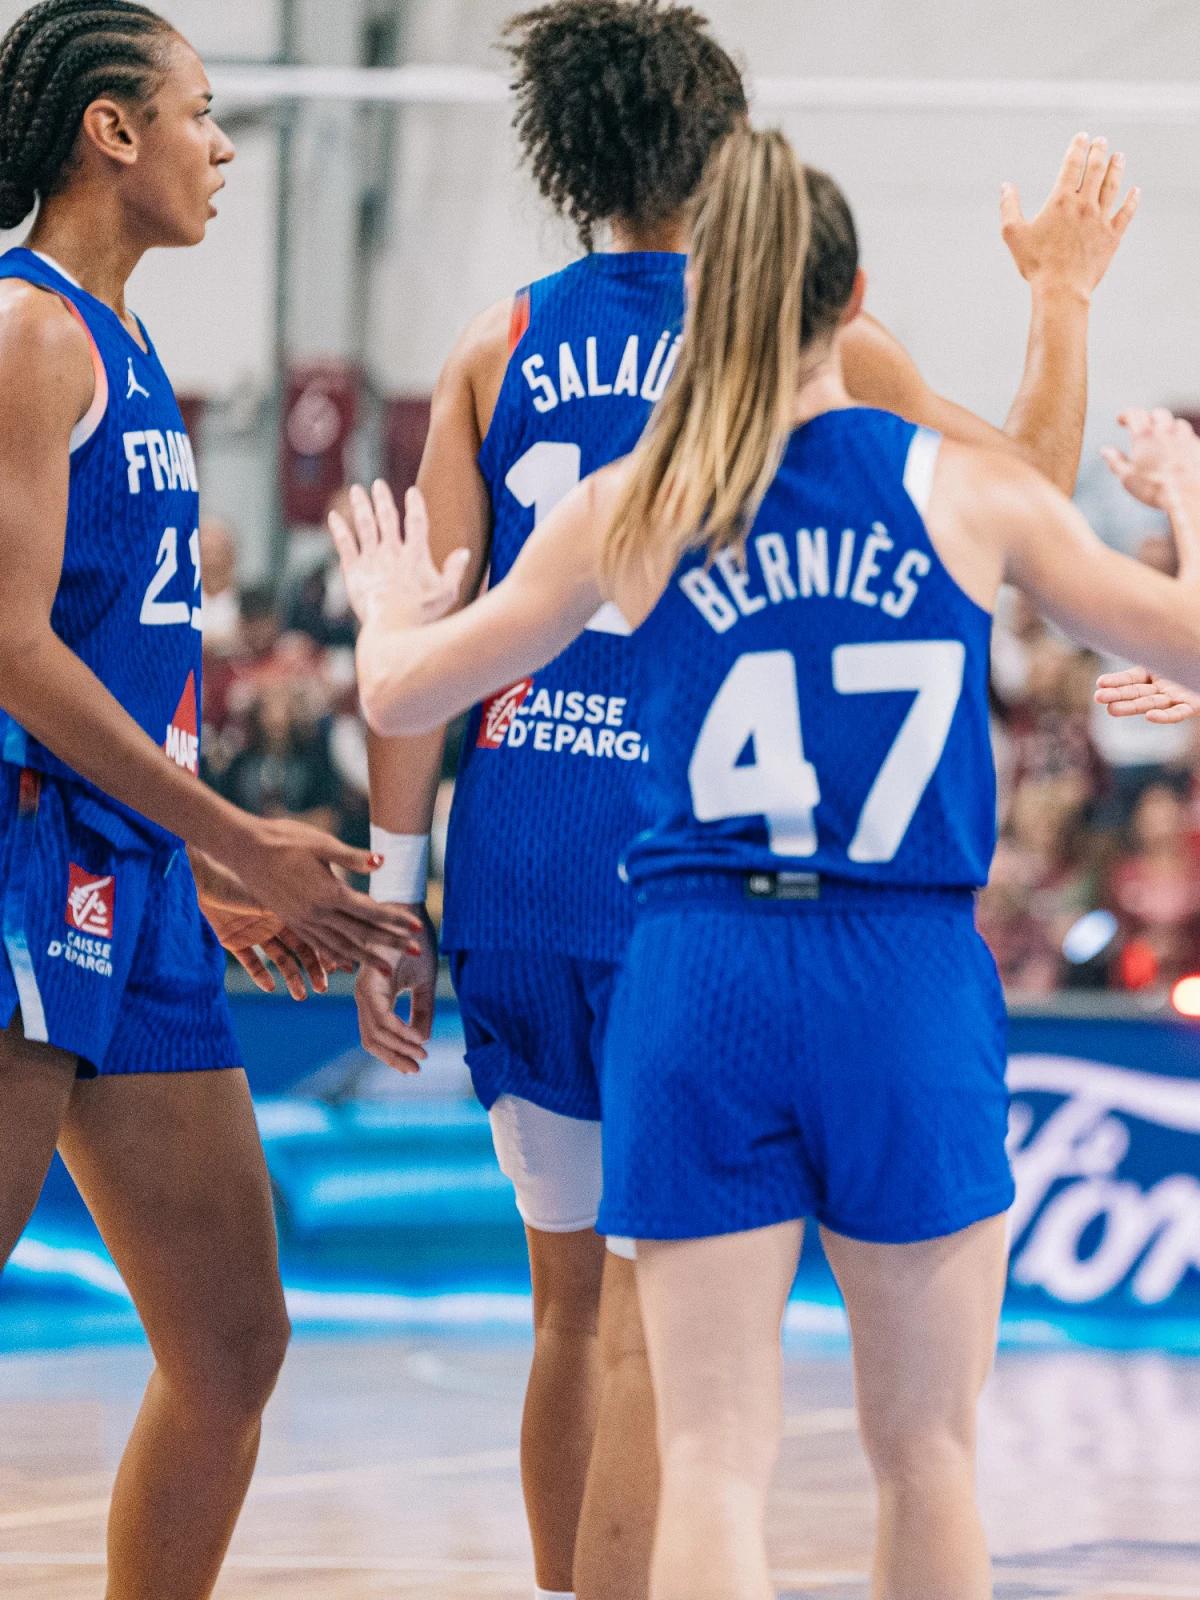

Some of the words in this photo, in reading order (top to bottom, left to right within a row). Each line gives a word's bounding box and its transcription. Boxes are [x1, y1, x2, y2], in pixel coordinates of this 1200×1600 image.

[678, 521, 931, 635] BERNIÈS
[507, 718, 650, 764] D'EPARG
[688, 639, 966, 864] 47
